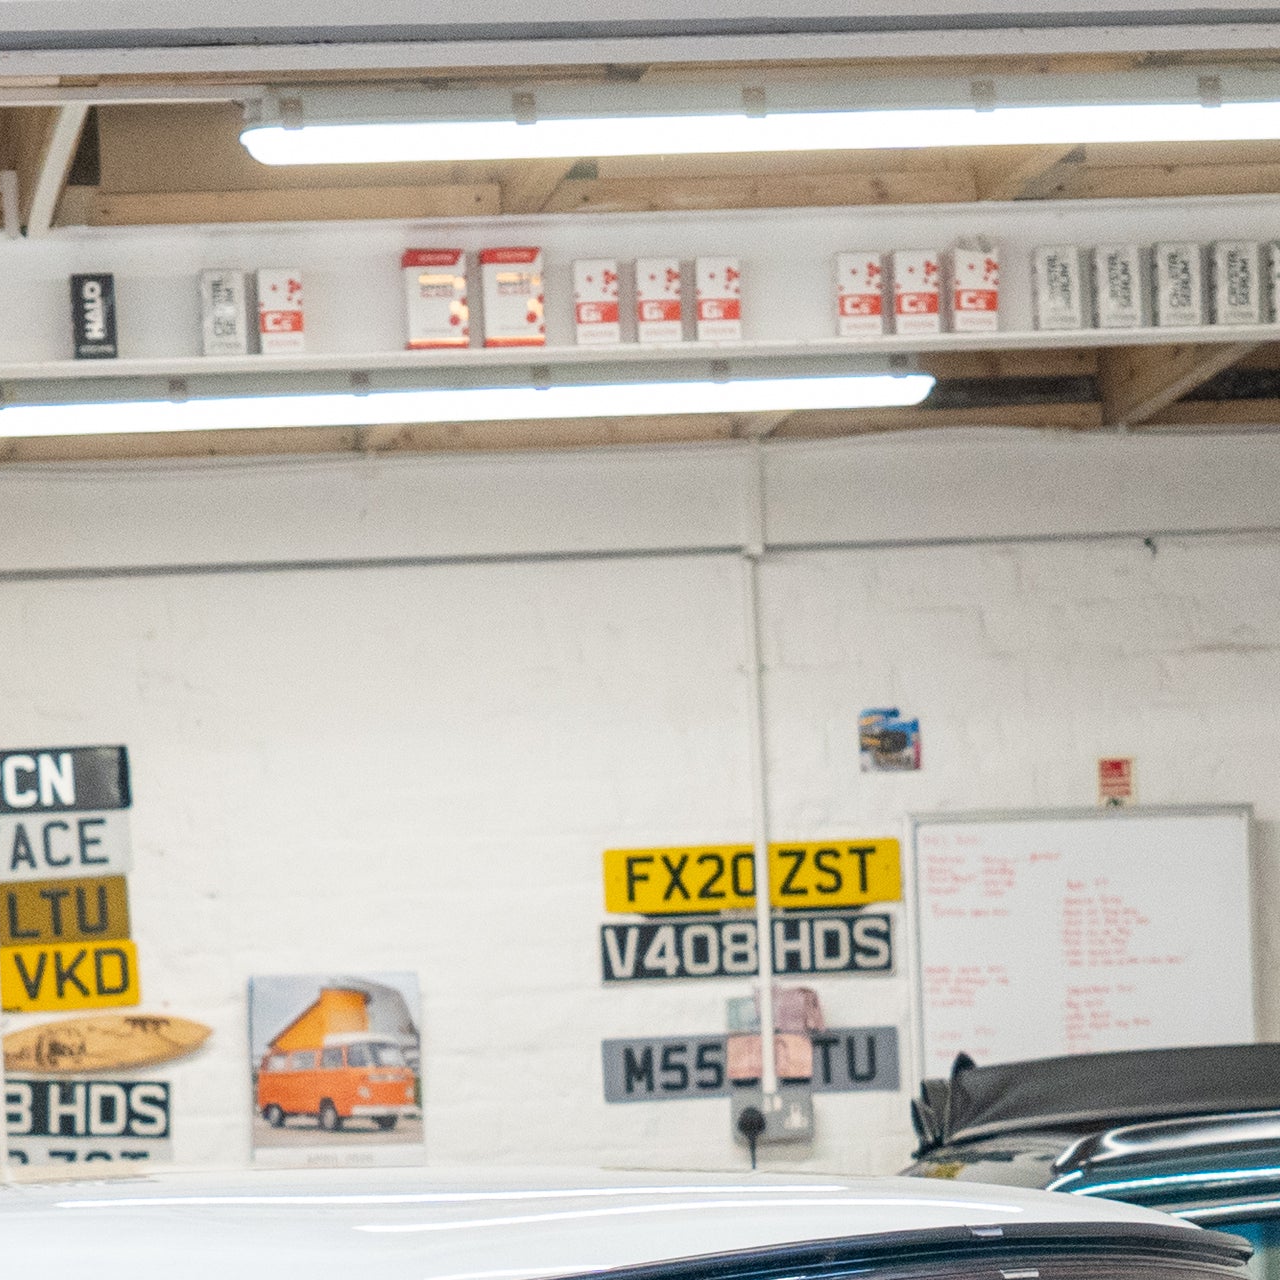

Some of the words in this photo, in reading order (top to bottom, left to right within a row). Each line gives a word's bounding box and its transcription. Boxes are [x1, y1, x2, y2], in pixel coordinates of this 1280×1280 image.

[82, 280, 105, 340] HALO
[626, 852, 757, 903] FX20
[778, 846, 876, 897] ZST
[6, 884, 110, 940] LTU
[14, 946, 130, 1001] VKD
[603, 922, 758, 978] V408
[774, 917, 890, 972] HDS
[623, 1044, 725, 1094] M55
[48, 1083, 168, 1137] HDS
